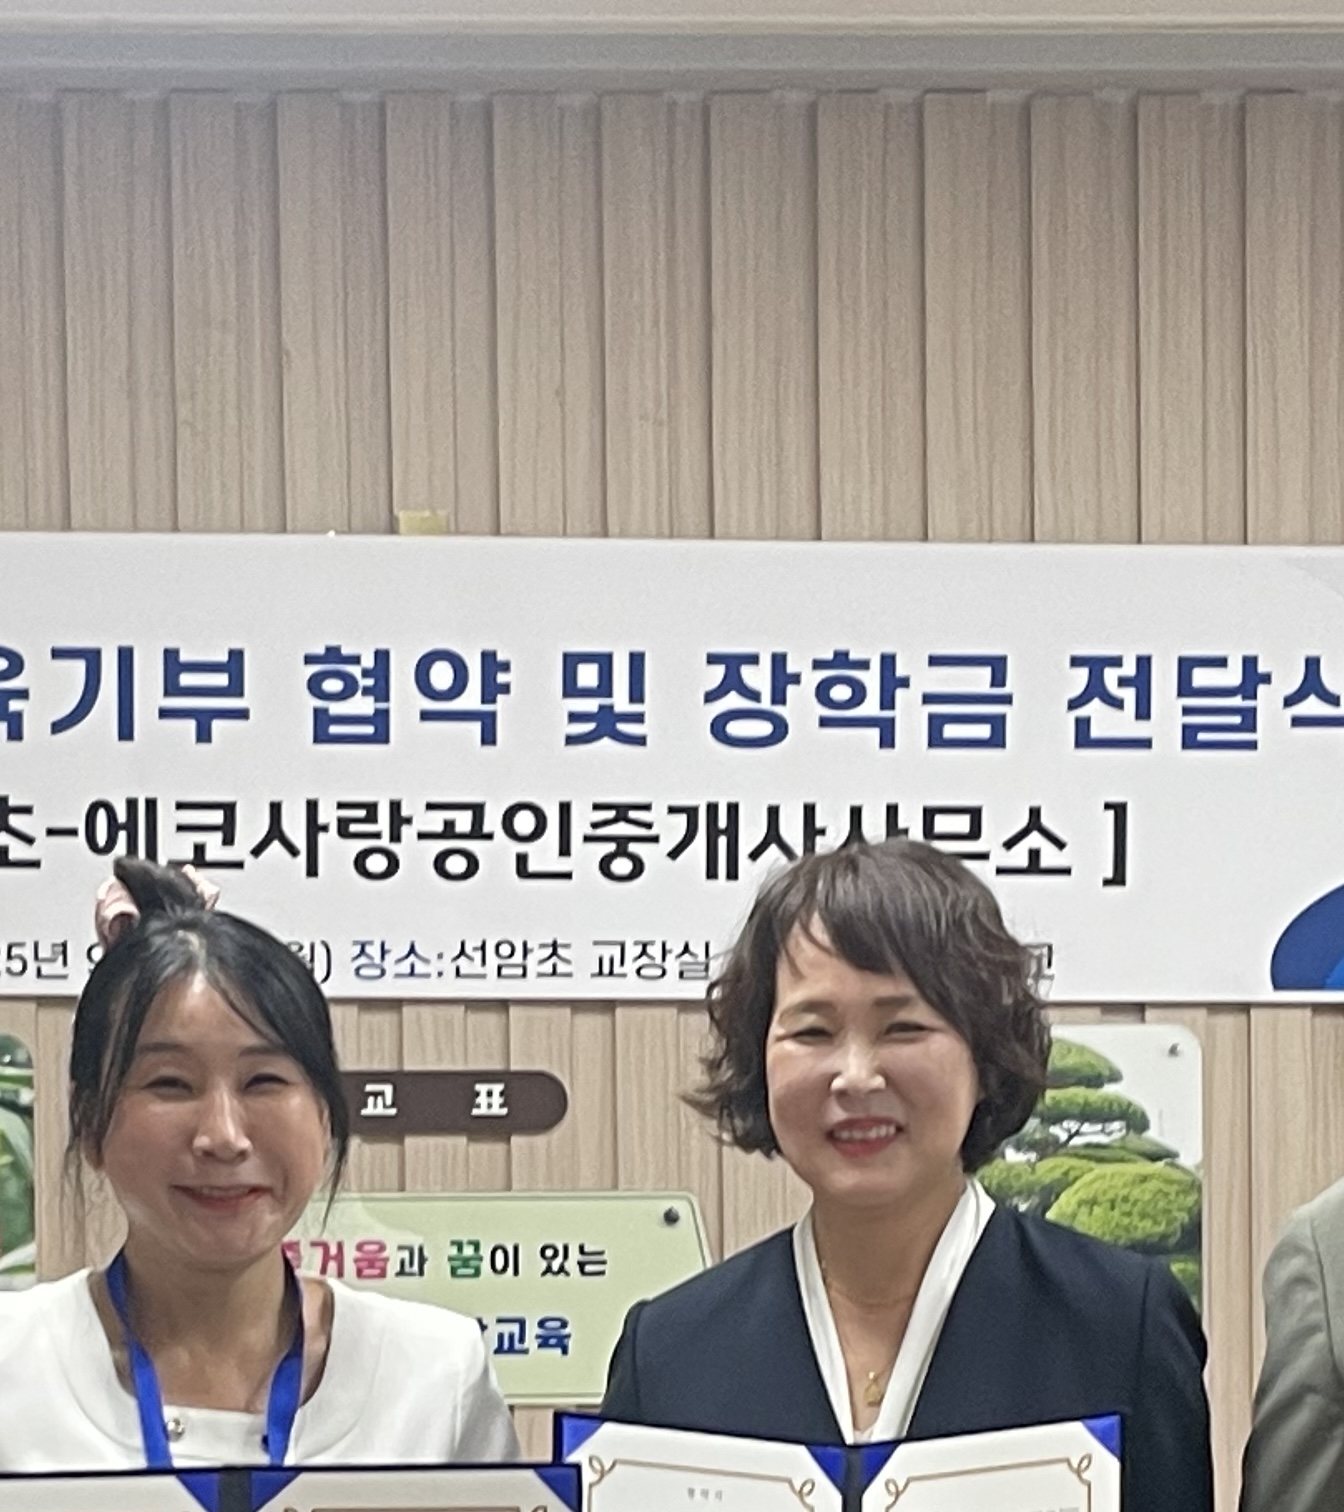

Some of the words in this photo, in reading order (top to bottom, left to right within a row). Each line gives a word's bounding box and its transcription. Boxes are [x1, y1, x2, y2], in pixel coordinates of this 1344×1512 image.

[303, 645, 511, 747] 협약
[561, 651, 648, 747] 및
[703, 649, 1014, 750] 장학금
[590, 939, 712, 980] 교장실
[447, 1239, 520, 1279] 꿈이
[539, 1242, 608, 1278] 있는
[477, 1316, 573, 1357] 교육
